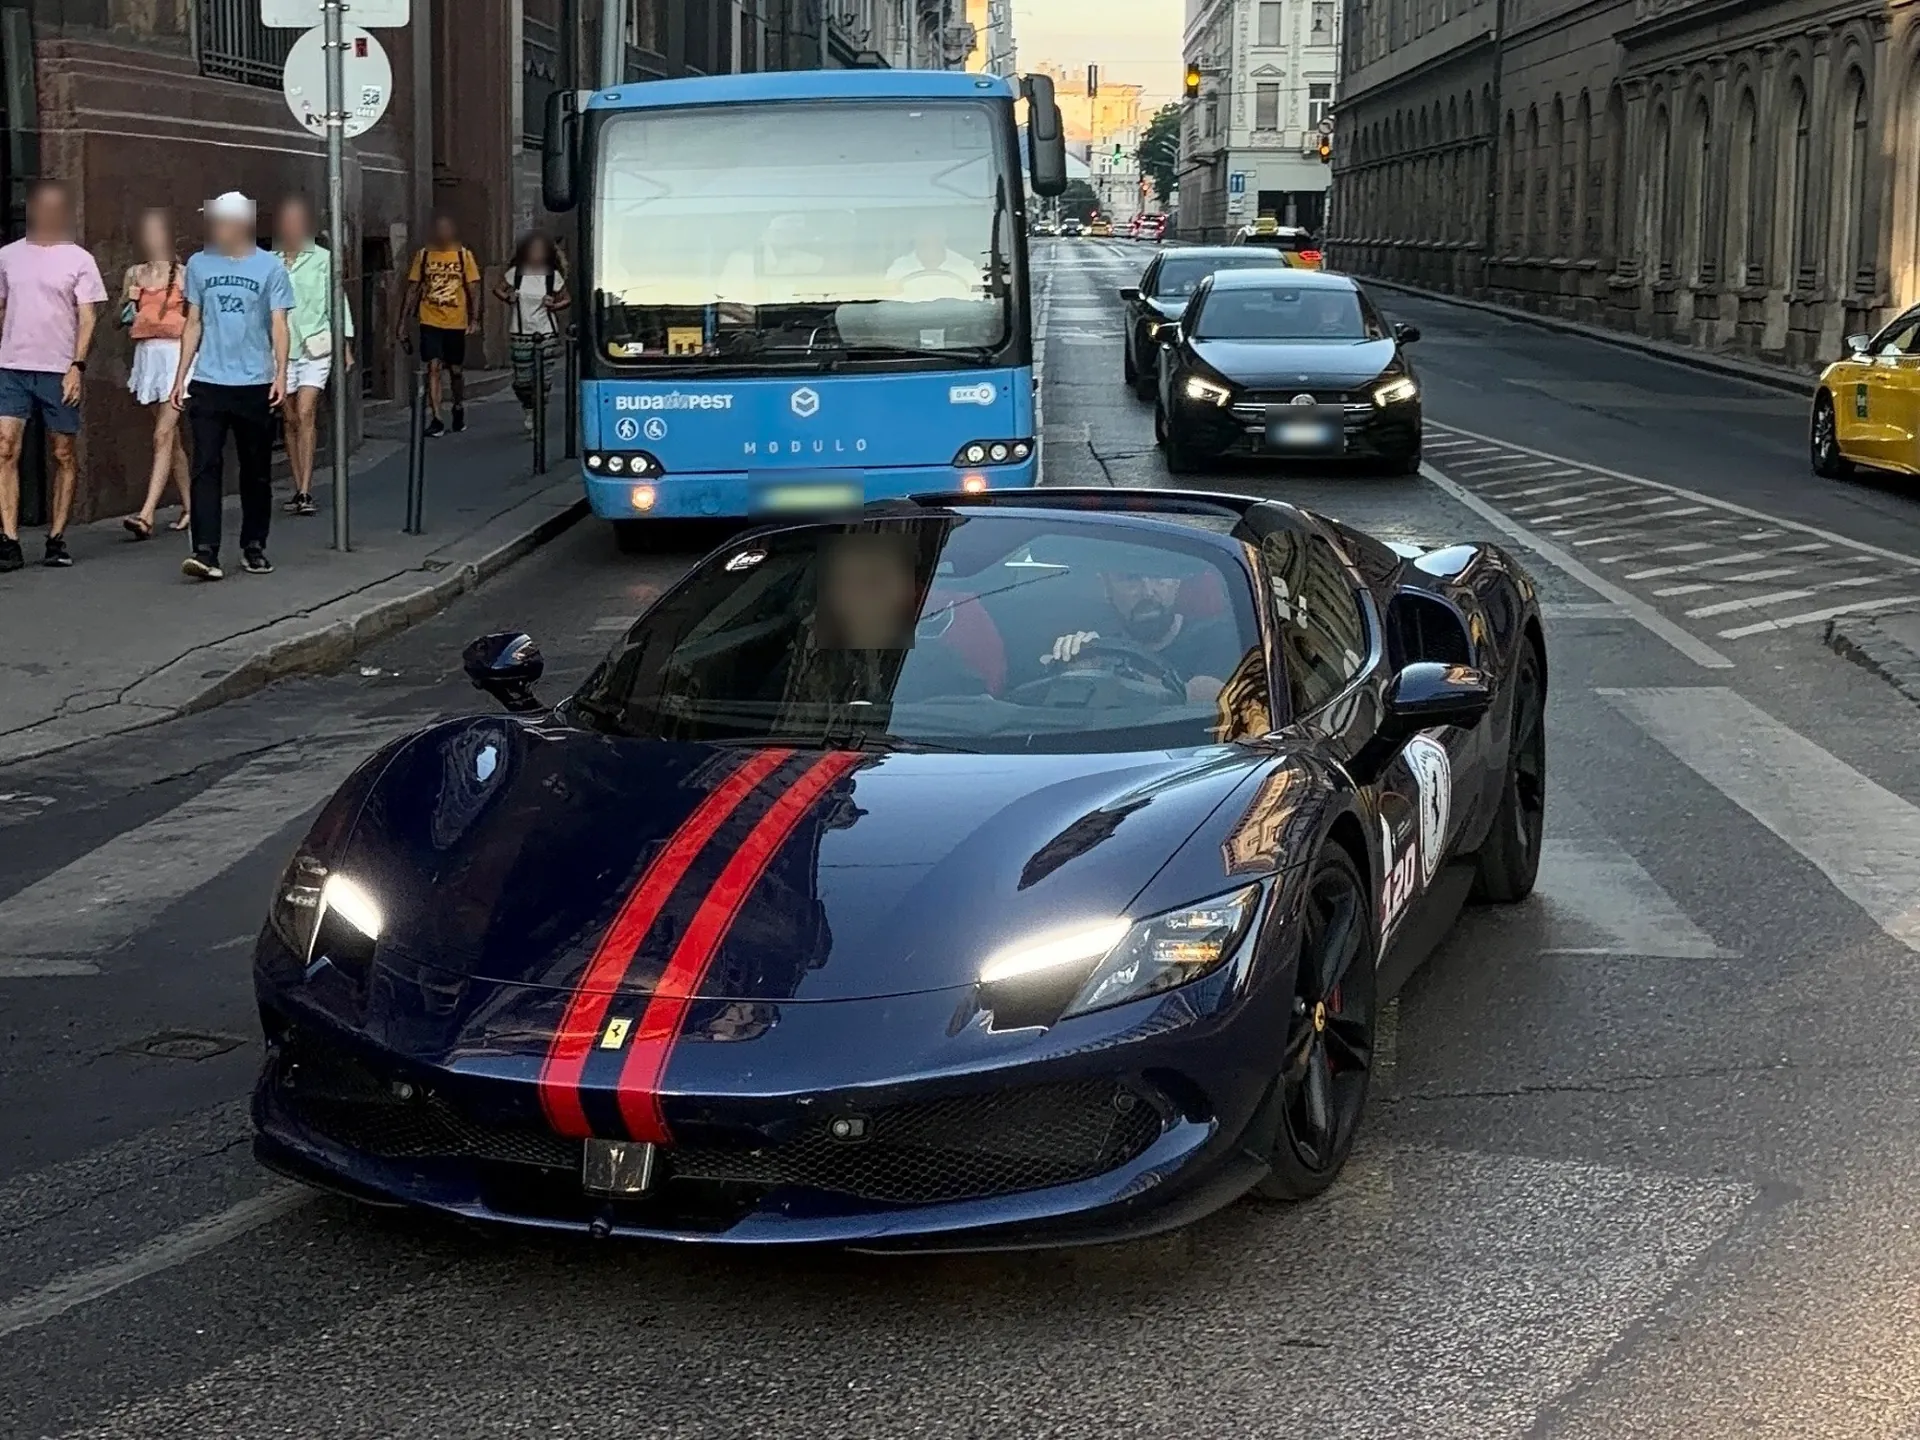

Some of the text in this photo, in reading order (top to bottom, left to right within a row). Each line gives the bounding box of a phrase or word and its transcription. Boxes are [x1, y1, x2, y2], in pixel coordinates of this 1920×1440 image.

[204, 275, 260, 295] MACALESTER
[743, 439, 868, 455] MODULO
[1380, 843, 1416, 934] 120
